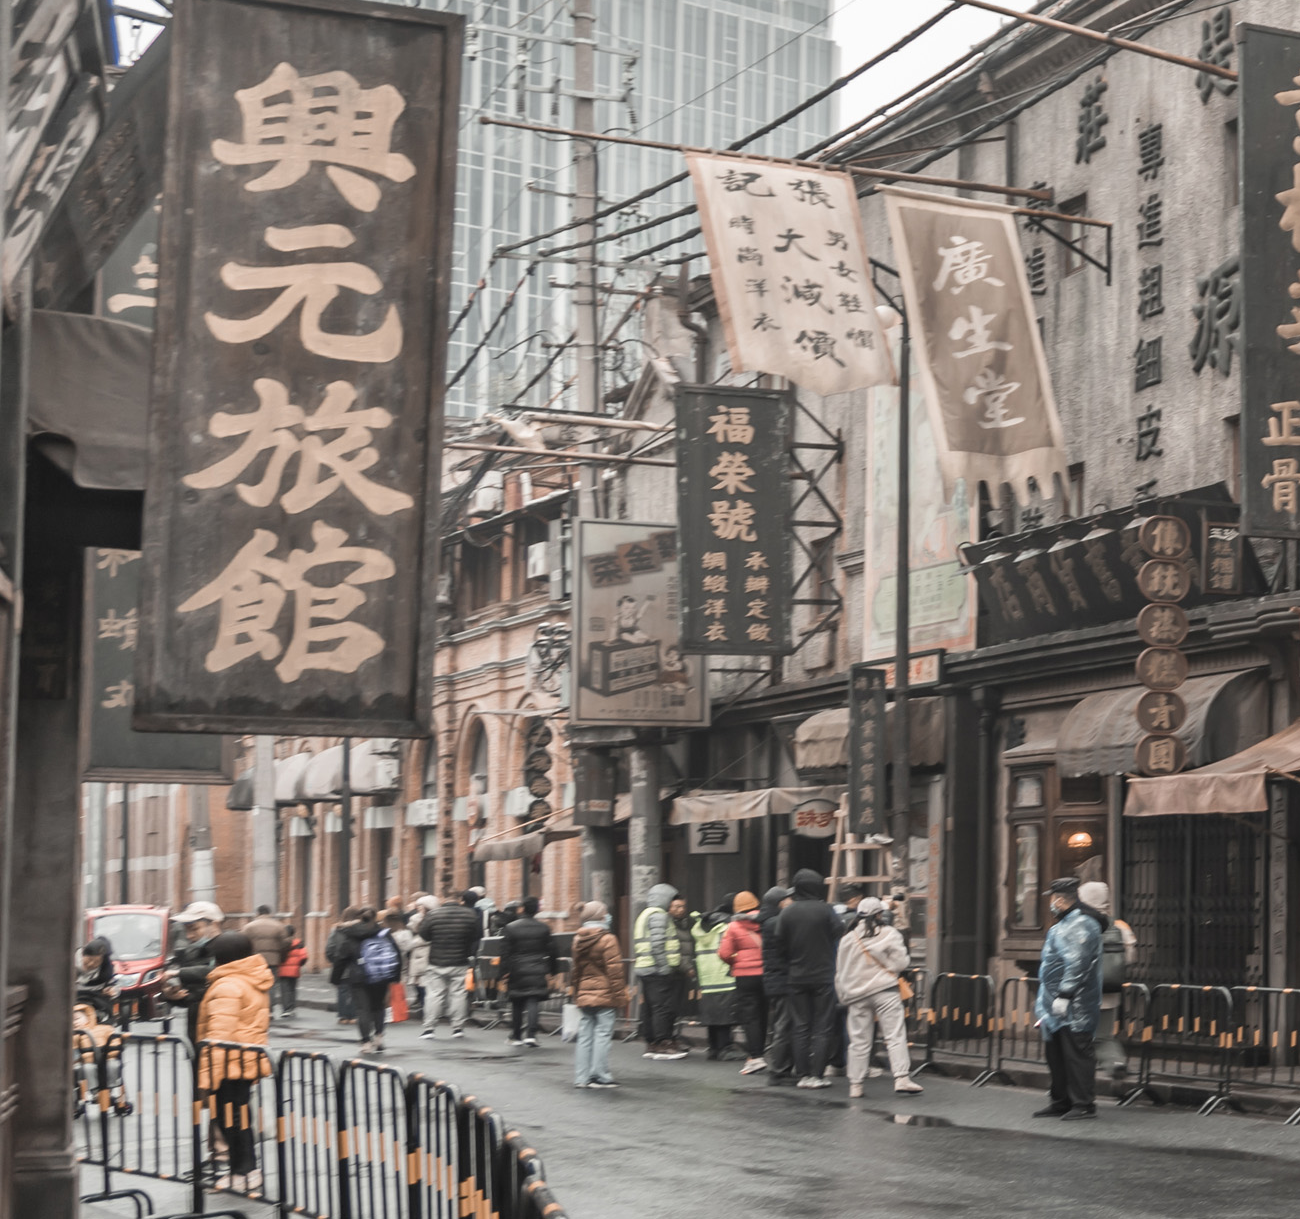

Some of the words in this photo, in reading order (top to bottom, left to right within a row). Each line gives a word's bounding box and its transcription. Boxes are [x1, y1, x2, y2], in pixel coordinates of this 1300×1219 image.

[177, 62, 417, 683] 興元旅館
[932, 235, 1026, 429] 廣生堂
[705, 404, 758, 542] 福榮號
